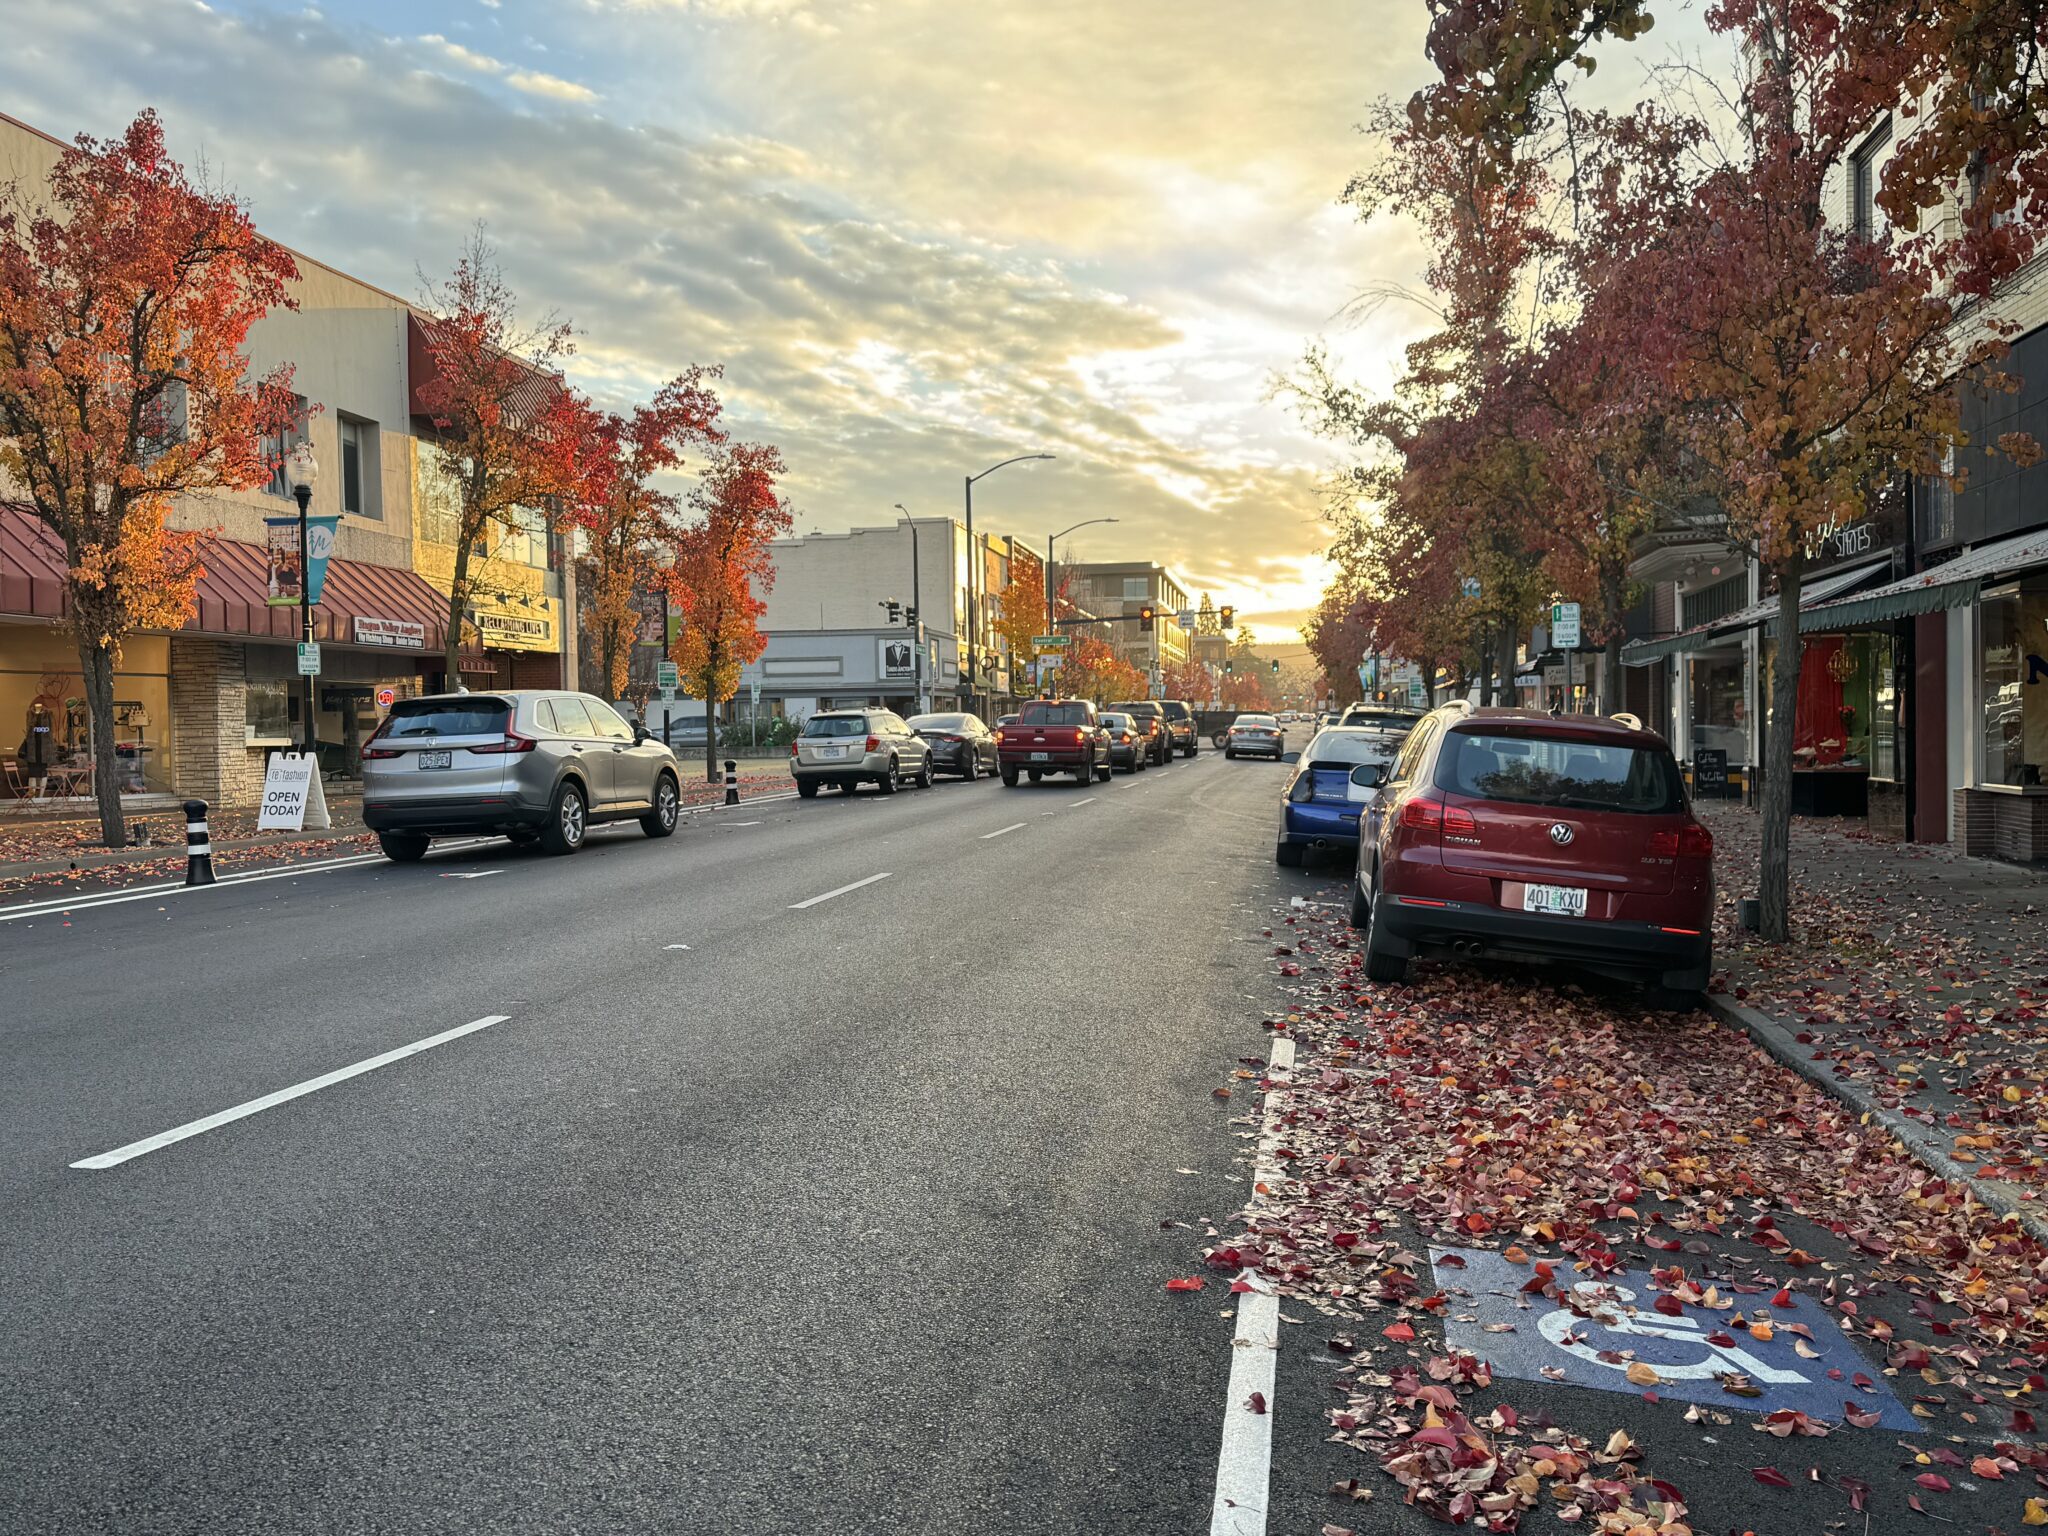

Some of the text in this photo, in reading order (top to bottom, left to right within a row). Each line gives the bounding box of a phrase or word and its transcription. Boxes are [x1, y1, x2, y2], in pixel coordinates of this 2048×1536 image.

[1836, 523, 1871, 557] SHOES
[358, 619, 380, 632] Rogue
[380, 621, 400, 635] Valley
[268, 791, 300, 802] OPEN
[263, 805, 301, 816] TODAY
[1444, 835, 1481, 846] TIGUAN
[1527, 888, 1583, 909] 401 KXU
